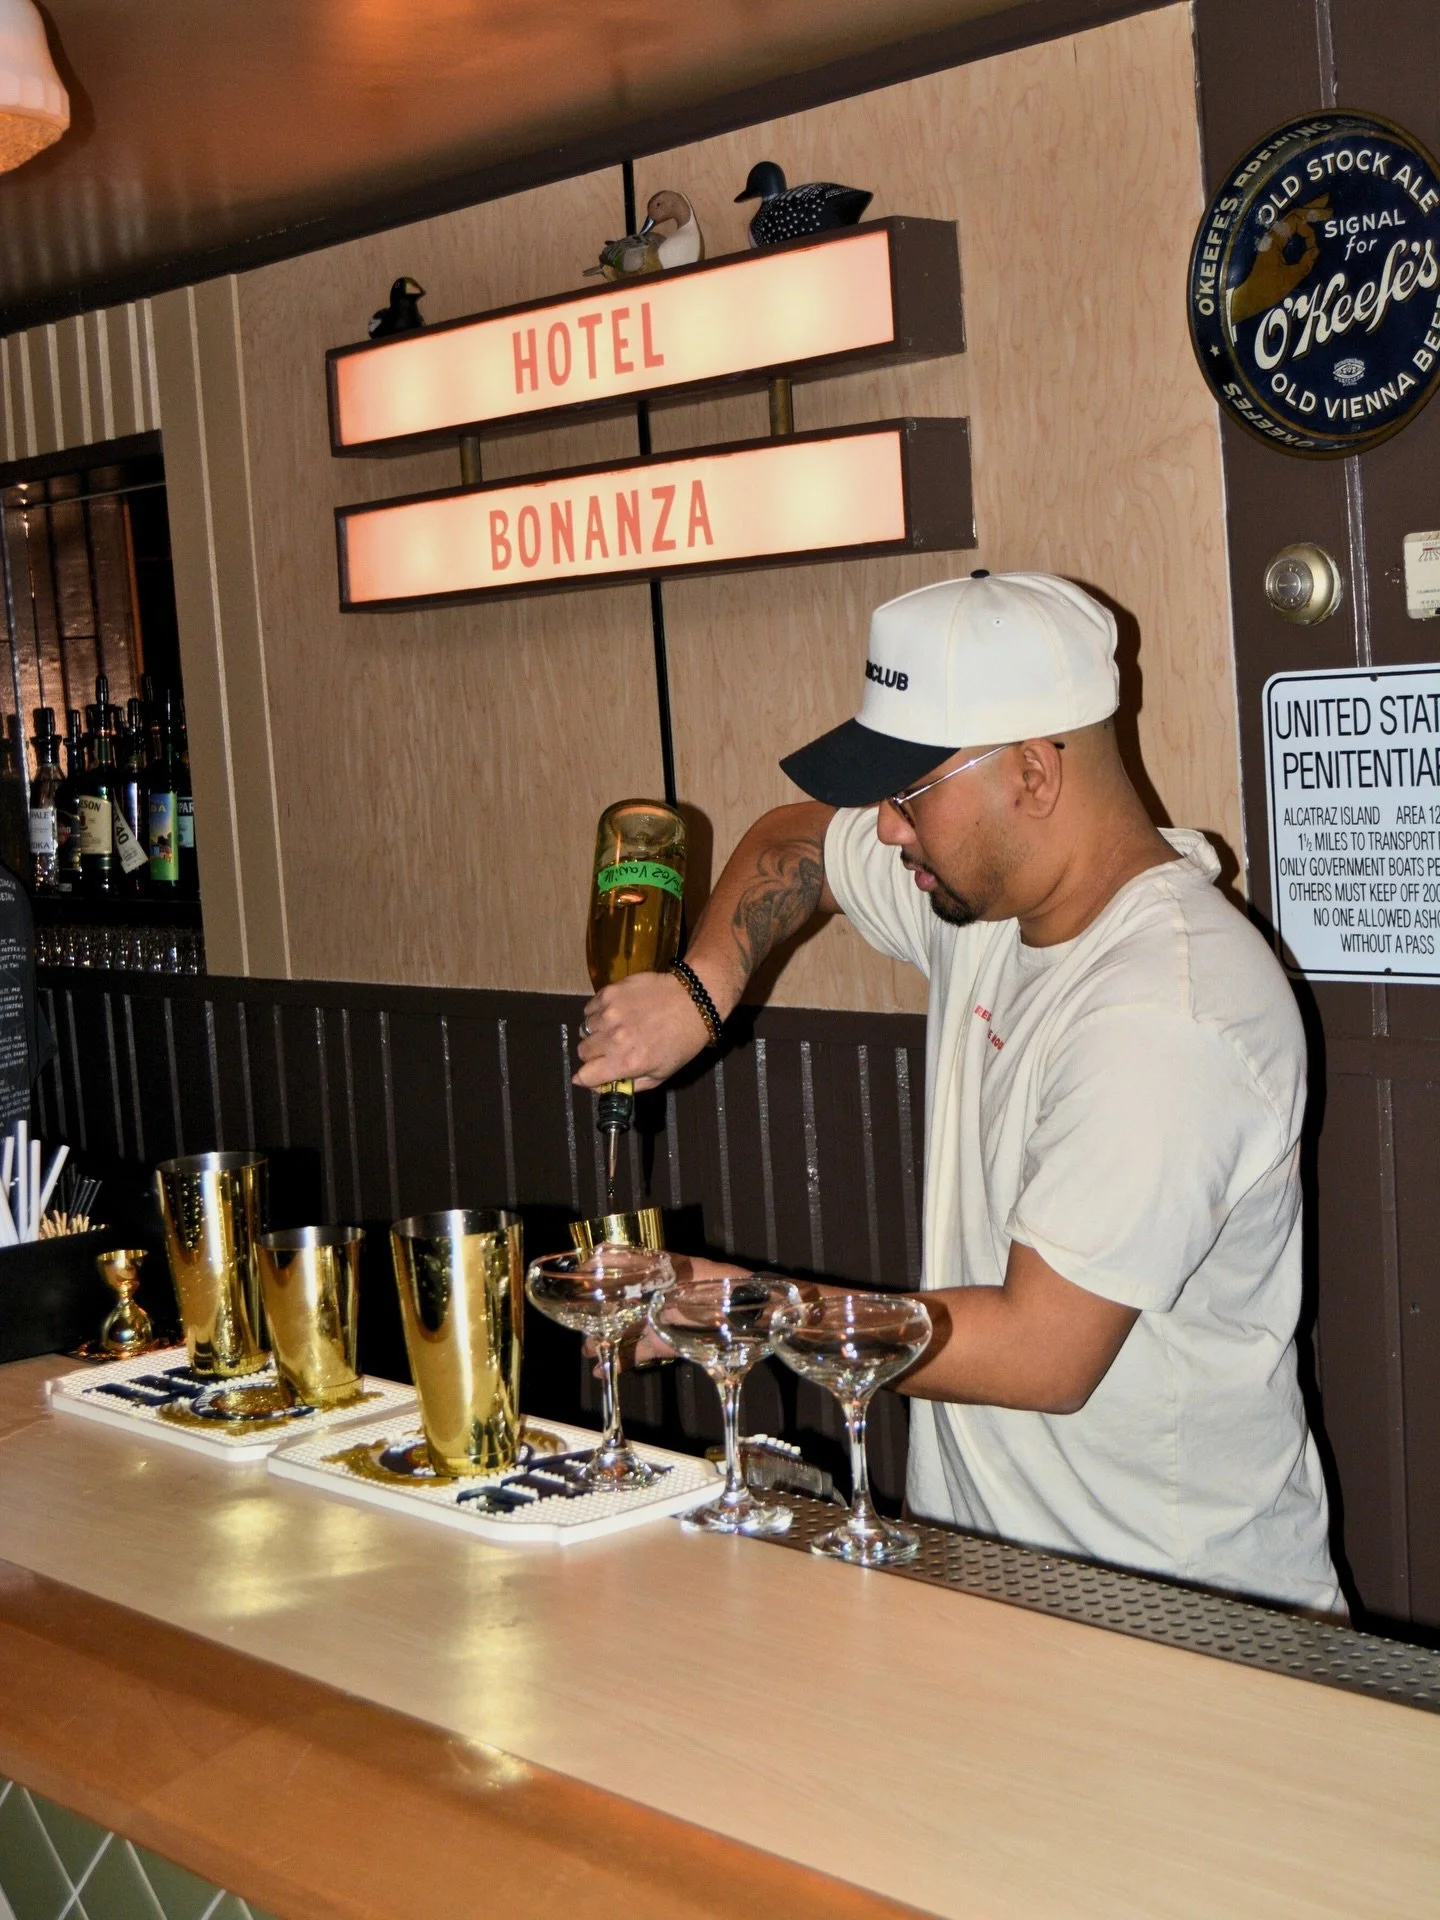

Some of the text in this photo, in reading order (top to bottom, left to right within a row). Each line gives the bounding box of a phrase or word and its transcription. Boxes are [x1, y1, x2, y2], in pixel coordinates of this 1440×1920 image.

[1258, 150, 1440, 224] OLD STOCK ALE
[1324, 209, 1406, 238] SIGNAL
[1344, 235, 1378, 261] for
[1254, 239, 1438, 370] O'Keefe's
[512, 302, 664, 394] HOTEL
[1271, 372, 1316, 413] OLD
[1324, 372, 1416, 419] VIENNA
[489, 480, 714, 572] BONANZA
[865, 660, 909, 691] CLUB
[1275, 694, 1440, 740] UNITED STAT
[1284, 807, 1338, 826] ALCATRAZ
[1341, 806, 1380, 825] ISLAND
[1396, 806, 1425, 825] AREA
[1315, 832, 1348, 851] MILES
[1351, 832, 1365, 850] TO
[1367, 831, 1436, 851] TRANSPORT
[1280, 857, 1307, 876] ONLY
[1309, 857, 1385, 876] GOVERNMENT
[1389, 857, 1424, 876] BOATS
[1289, 882, 1332, 902] OTHERS
[1335, 883, 1366, 901] MUST
[1369, 883, 1397, 901] KEEP
[1400, 883, 1420, 902] OFF
[1314, 908, 1329, 926] NO
[1332, 908, 1354, 927] ONE
[1358, 908, 1411, 928] ALLOWED
[1340, 934, 1434, 954] WITHOUT A PASS
